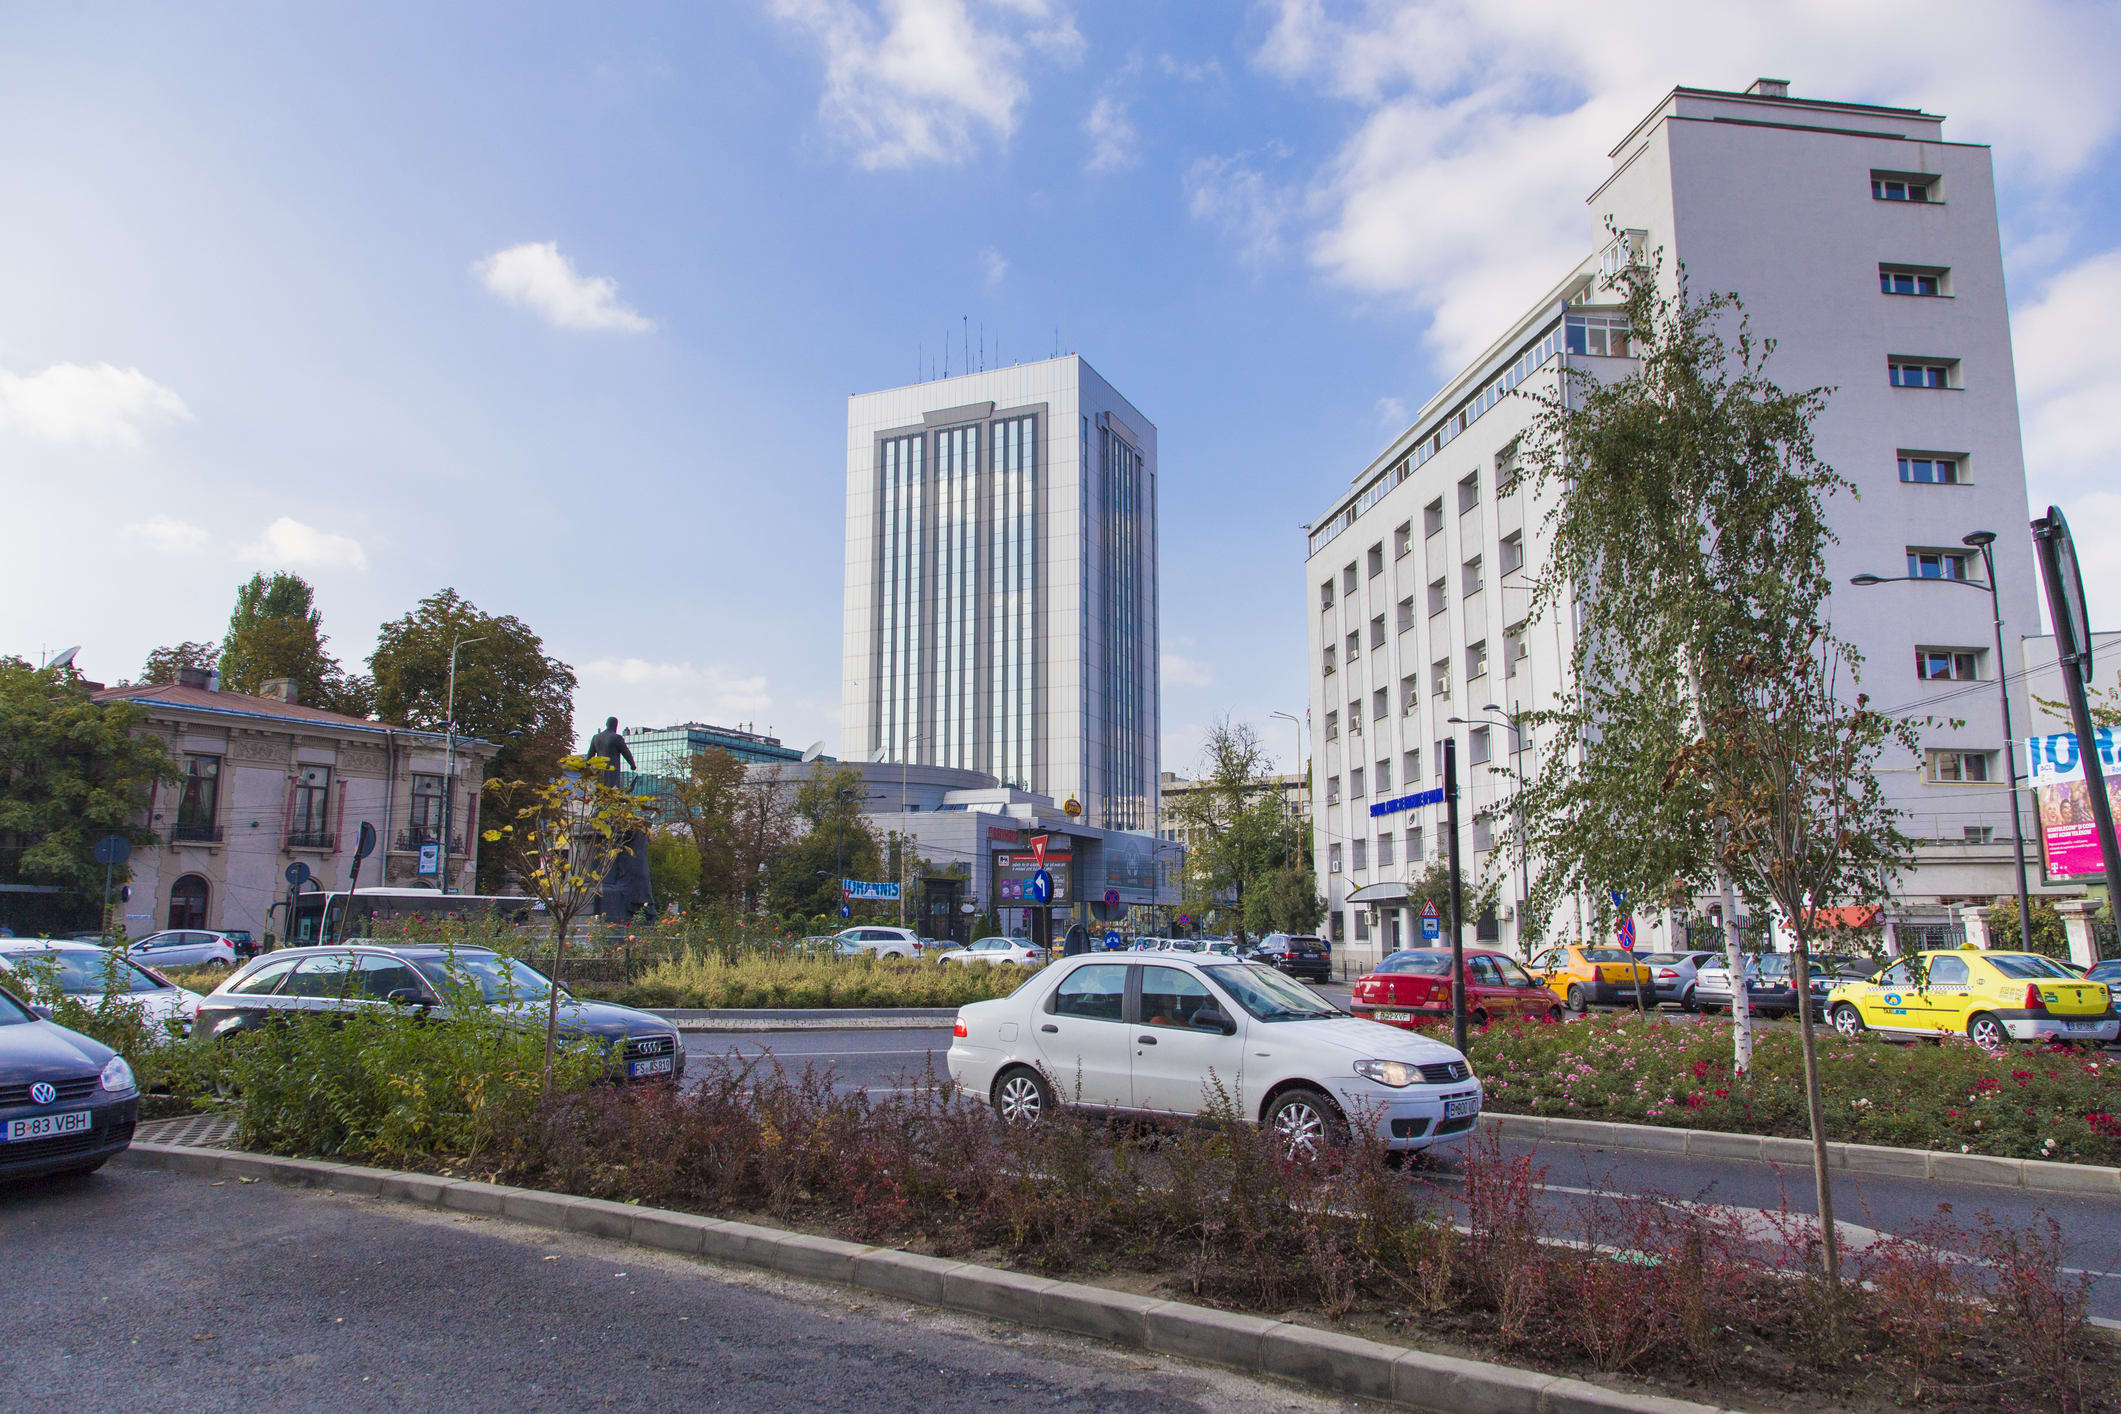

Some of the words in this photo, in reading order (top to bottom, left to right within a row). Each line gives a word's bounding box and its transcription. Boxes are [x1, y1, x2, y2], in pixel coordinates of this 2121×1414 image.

[14, 1121, 26, 1138] B
[32, 1119, 50, 1134] 83
[55, 1112, 86, 1131] VBH
